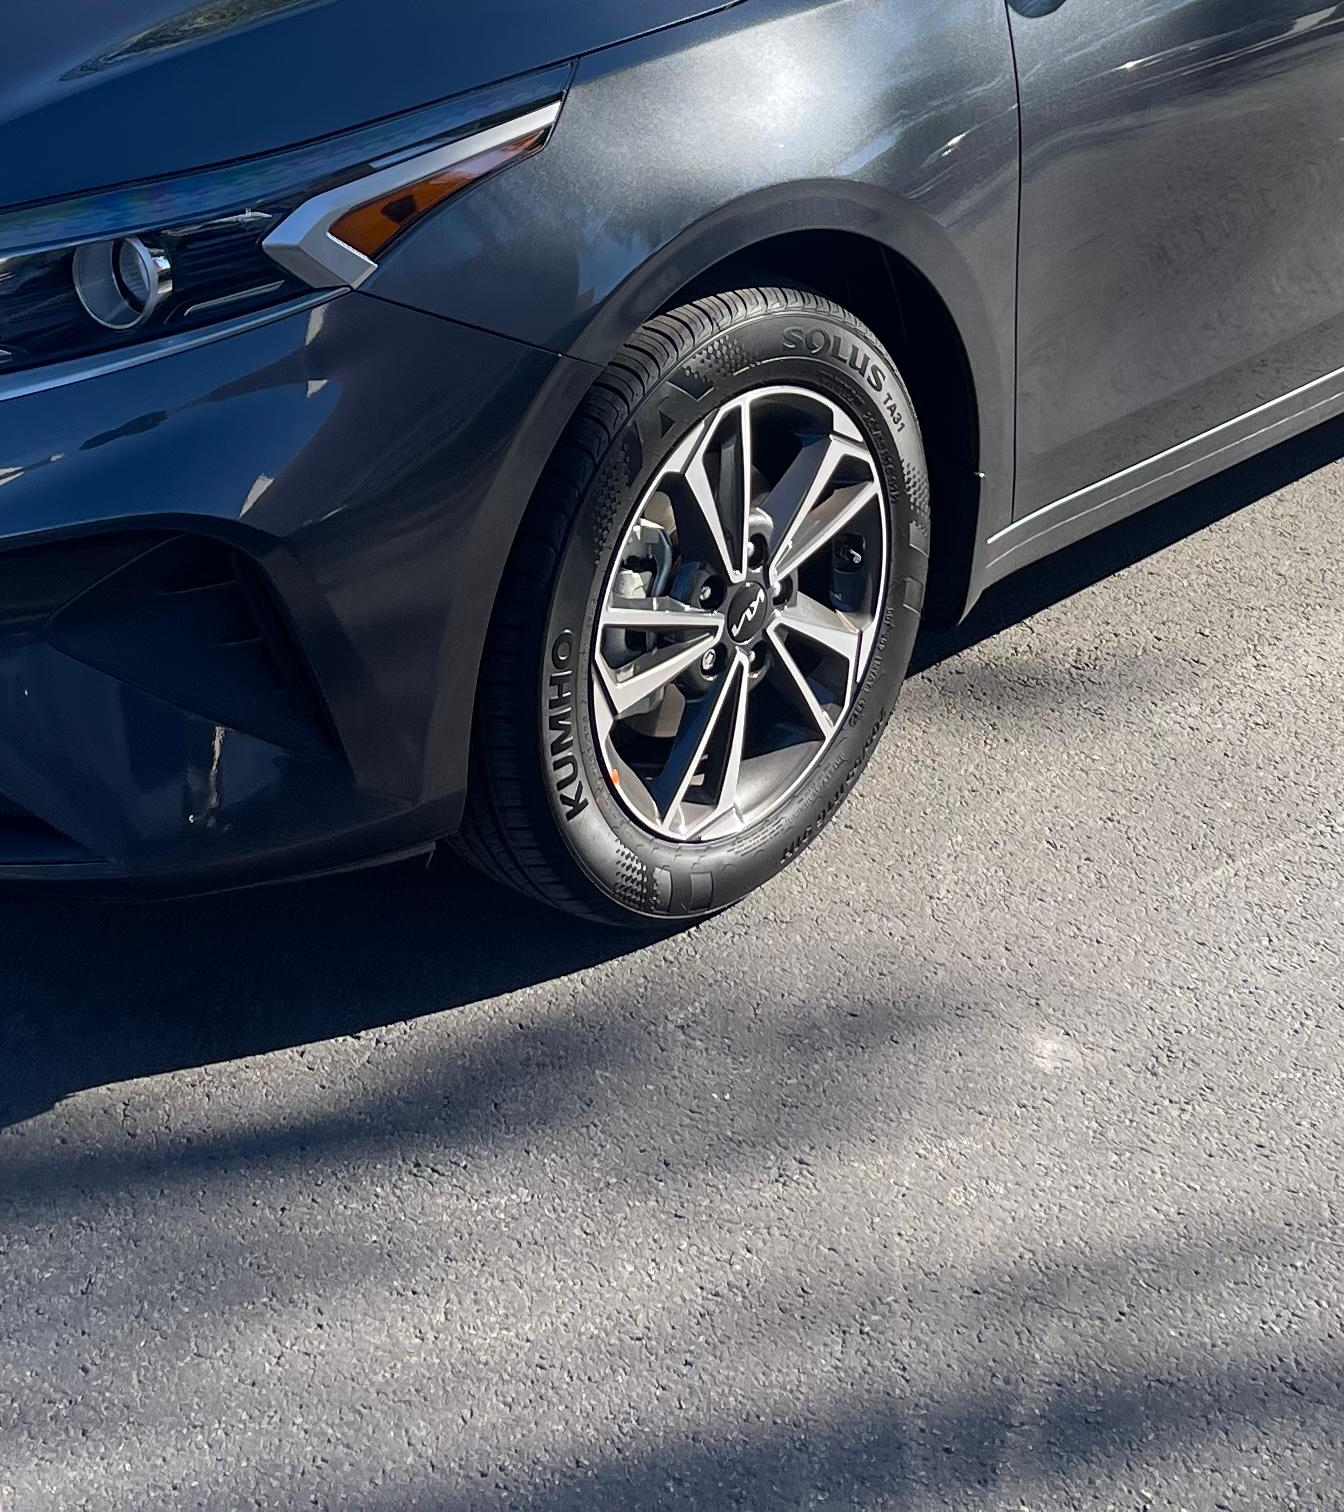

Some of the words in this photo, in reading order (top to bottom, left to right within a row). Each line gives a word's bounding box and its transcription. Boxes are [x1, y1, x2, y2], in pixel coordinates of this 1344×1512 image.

[782, 326, 886, 392] SOLUS
[883, 392, 905, 432] TA31
[549, 629, 589, 821] KUMHO
